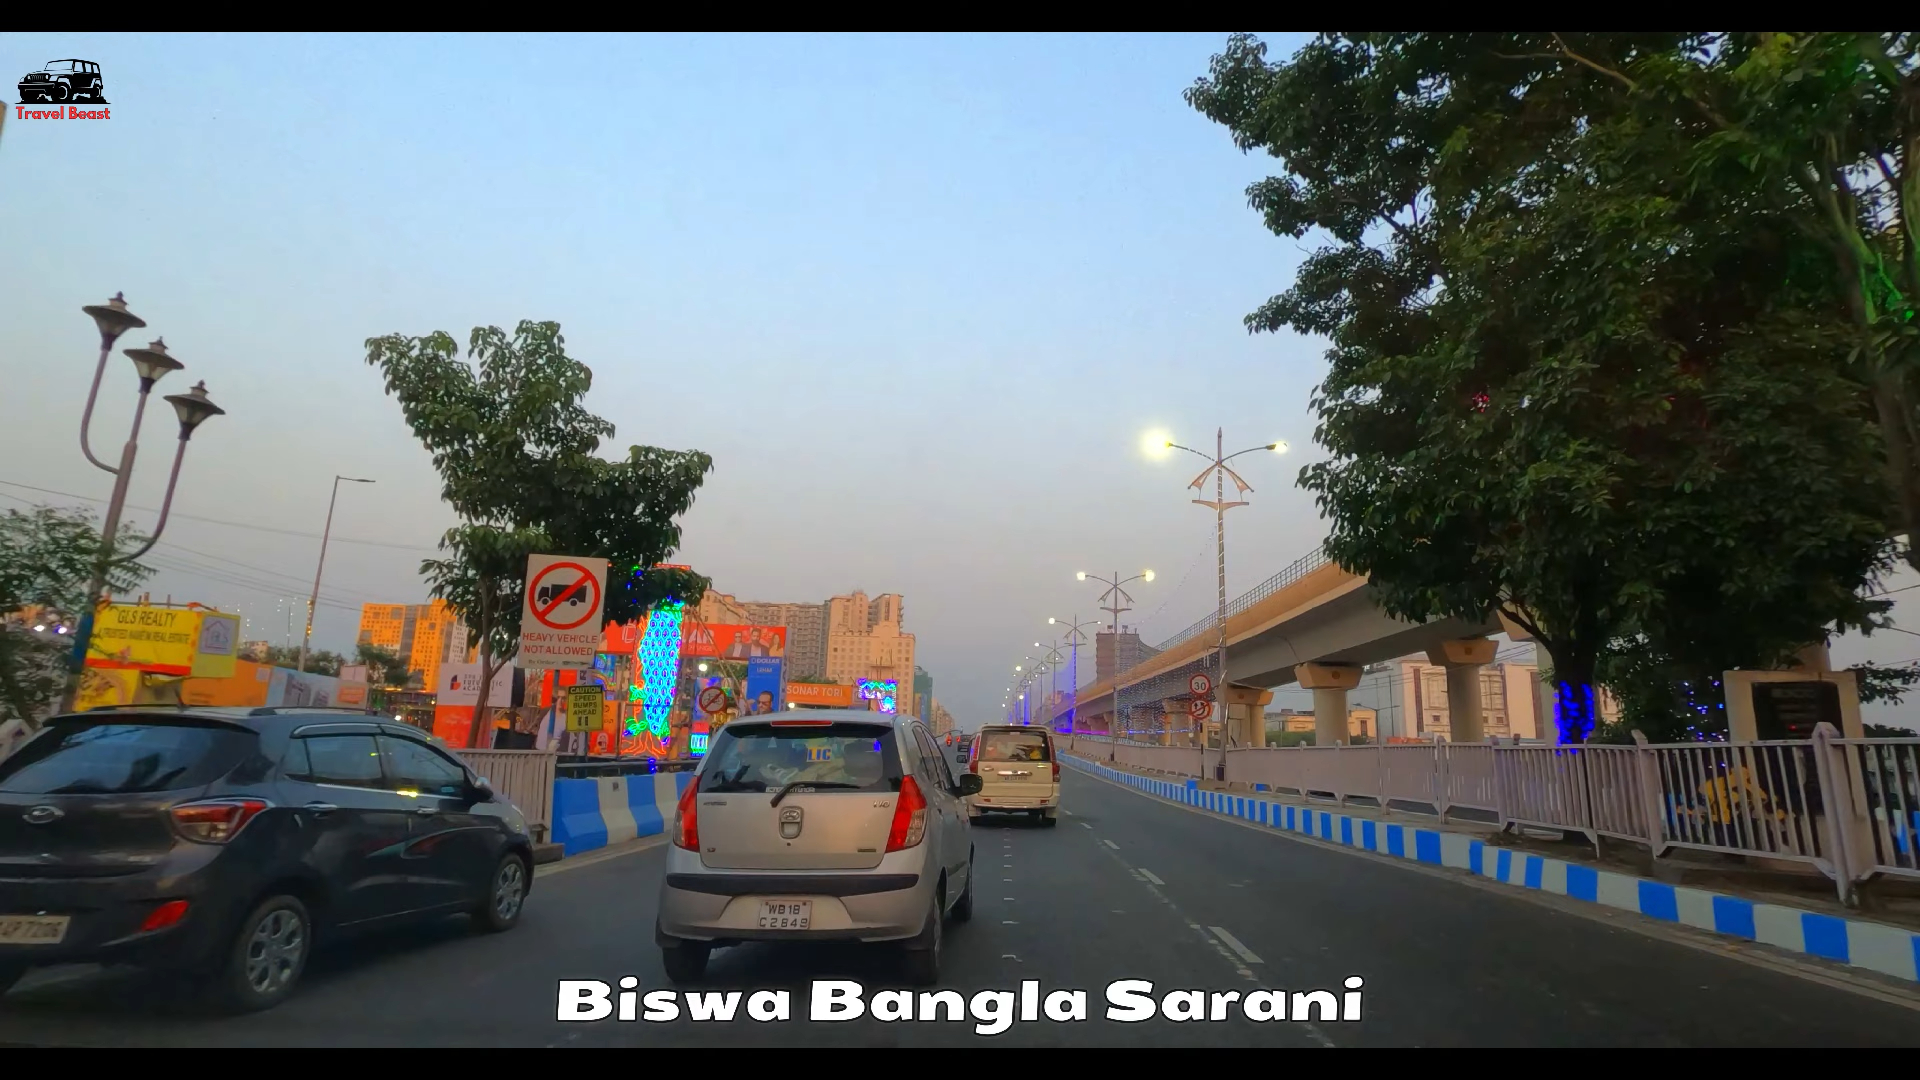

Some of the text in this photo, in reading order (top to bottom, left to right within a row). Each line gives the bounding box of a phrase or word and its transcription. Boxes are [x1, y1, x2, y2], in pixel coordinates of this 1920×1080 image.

[140, 612, 177, 627] REALTY
[522, 633, 598, 644] HEAVY VEHICLE
[524, 645, 593, 656] NOT ALLOWED
[787, 685, 843, 697] SONAR TORI
[1194, 682, 1206, 690] 30
[808, 748, 831, 760] LIC
